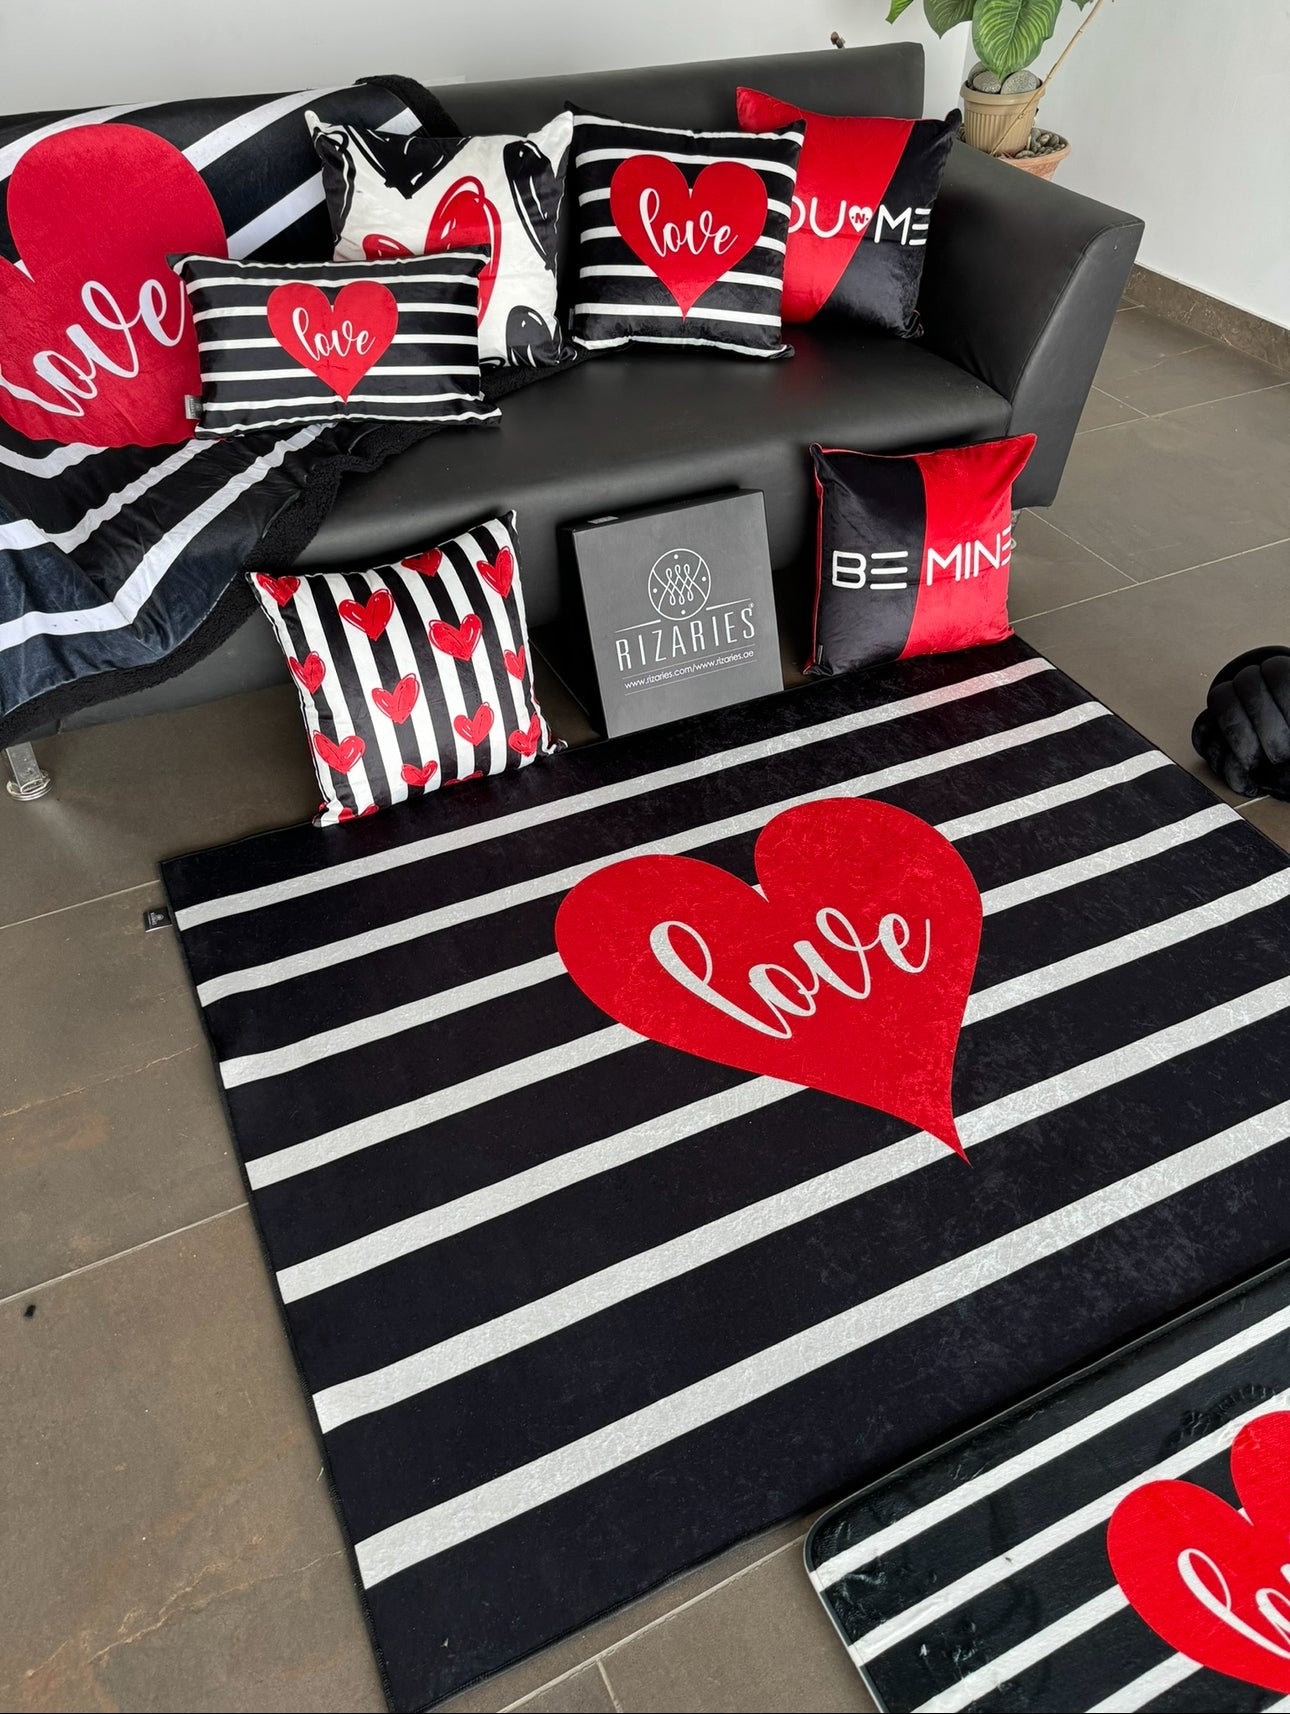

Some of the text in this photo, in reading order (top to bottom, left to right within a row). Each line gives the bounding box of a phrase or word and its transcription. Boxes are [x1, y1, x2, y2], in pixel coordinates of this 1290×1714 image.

[639, 187, 738, 258] love
[874, 204, 931, 246] ME
[292, 307, 376, 361] love
[832, 524, 1012, 590] BE MINE
[615, 607, 756, 672] RIZARIES
[649, 907, 930, 1040] love
